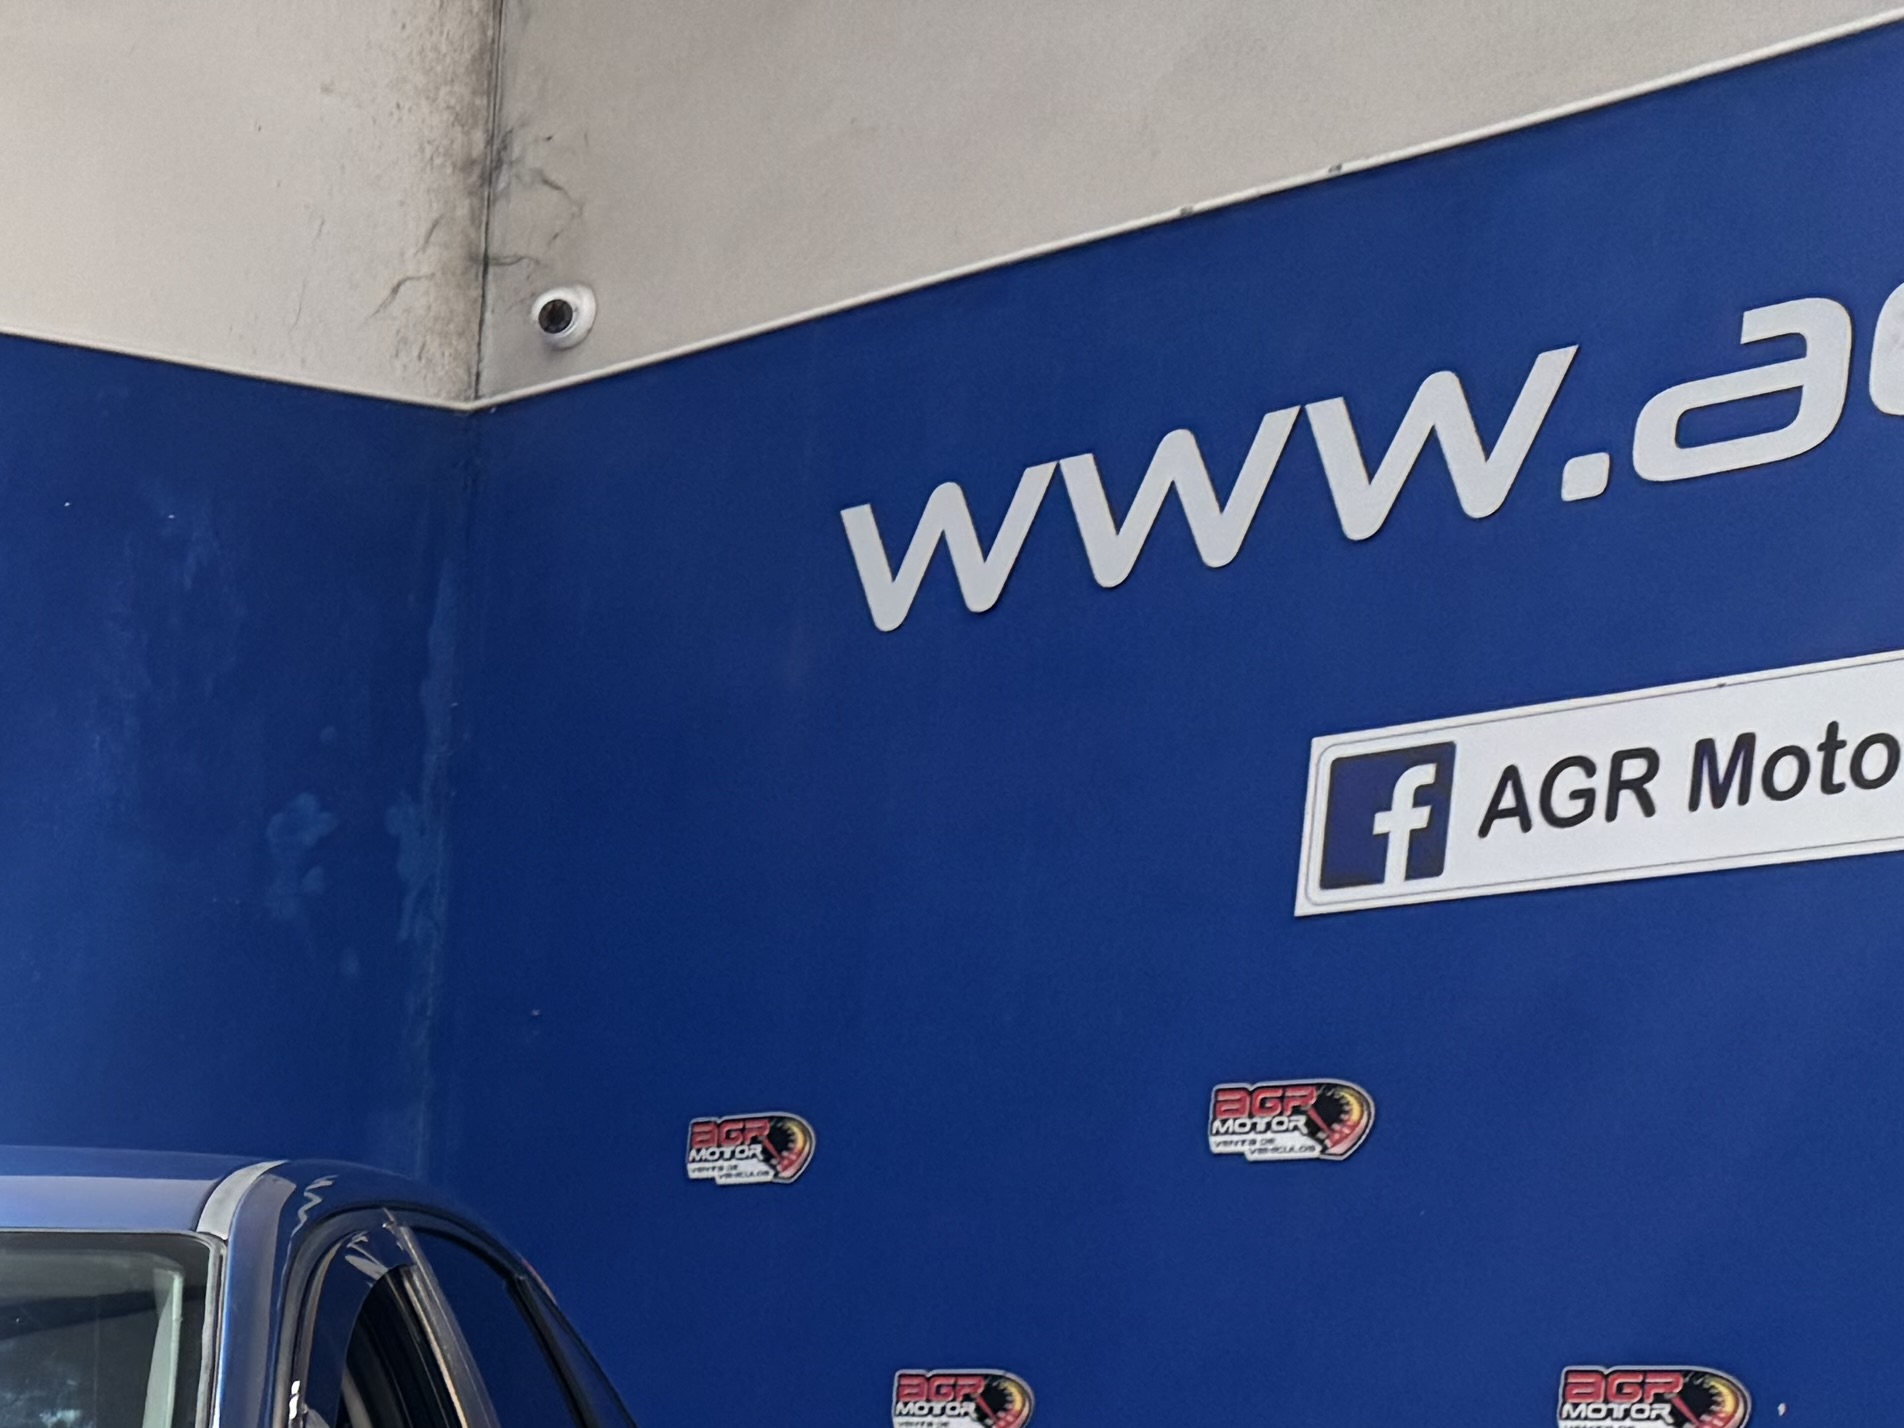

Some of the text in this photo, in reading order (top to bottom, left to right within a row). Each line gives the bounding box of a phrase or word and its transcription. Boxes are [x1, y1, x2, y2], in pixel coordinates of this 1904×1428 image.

[841, 281, 1904, 632] www.a
[1478, 747, 1660, 838] AGR
[1689, 721, 1902, 812] Moto
[1212, 1115, 1309, 1134] MOTOR
[1562, 1402, 1675, 1423] MOTOR
